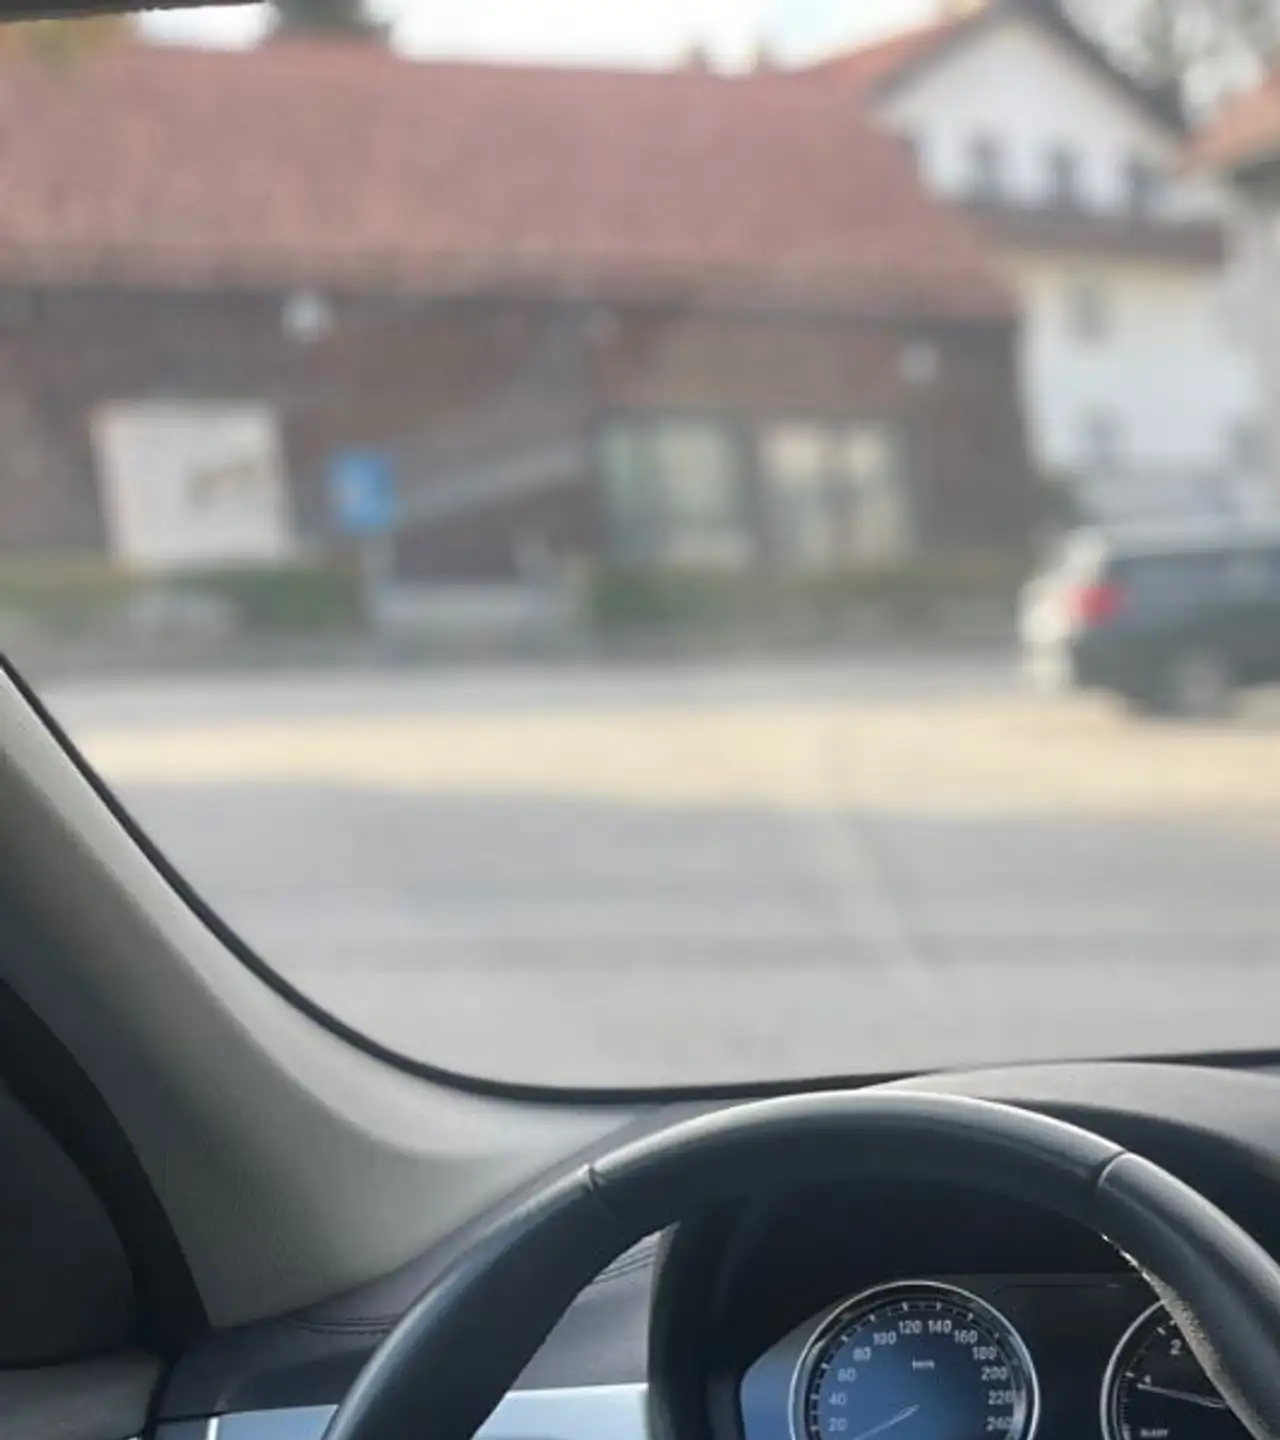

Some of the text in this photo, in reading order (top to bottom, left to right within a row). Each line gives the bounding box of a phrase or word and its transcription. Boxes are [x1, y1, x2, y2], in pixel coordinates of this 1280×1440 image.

[898, 1320, 923, 1333] 120
[928, 1319, 952, 1334] 140
[873, 1331, 896, 1345] 100
[953, 1329, 978, 1344] 160
[853, 1345, 871, 1361] 80
[1170, 1338, 1182, 1355] 2
[981, 1365, 1008, 1381] 200
[828, 1391, 847, 1405] 40
[988, 1390, 1018, 1405] 220
[828, 1417, 847, 1432] 20
